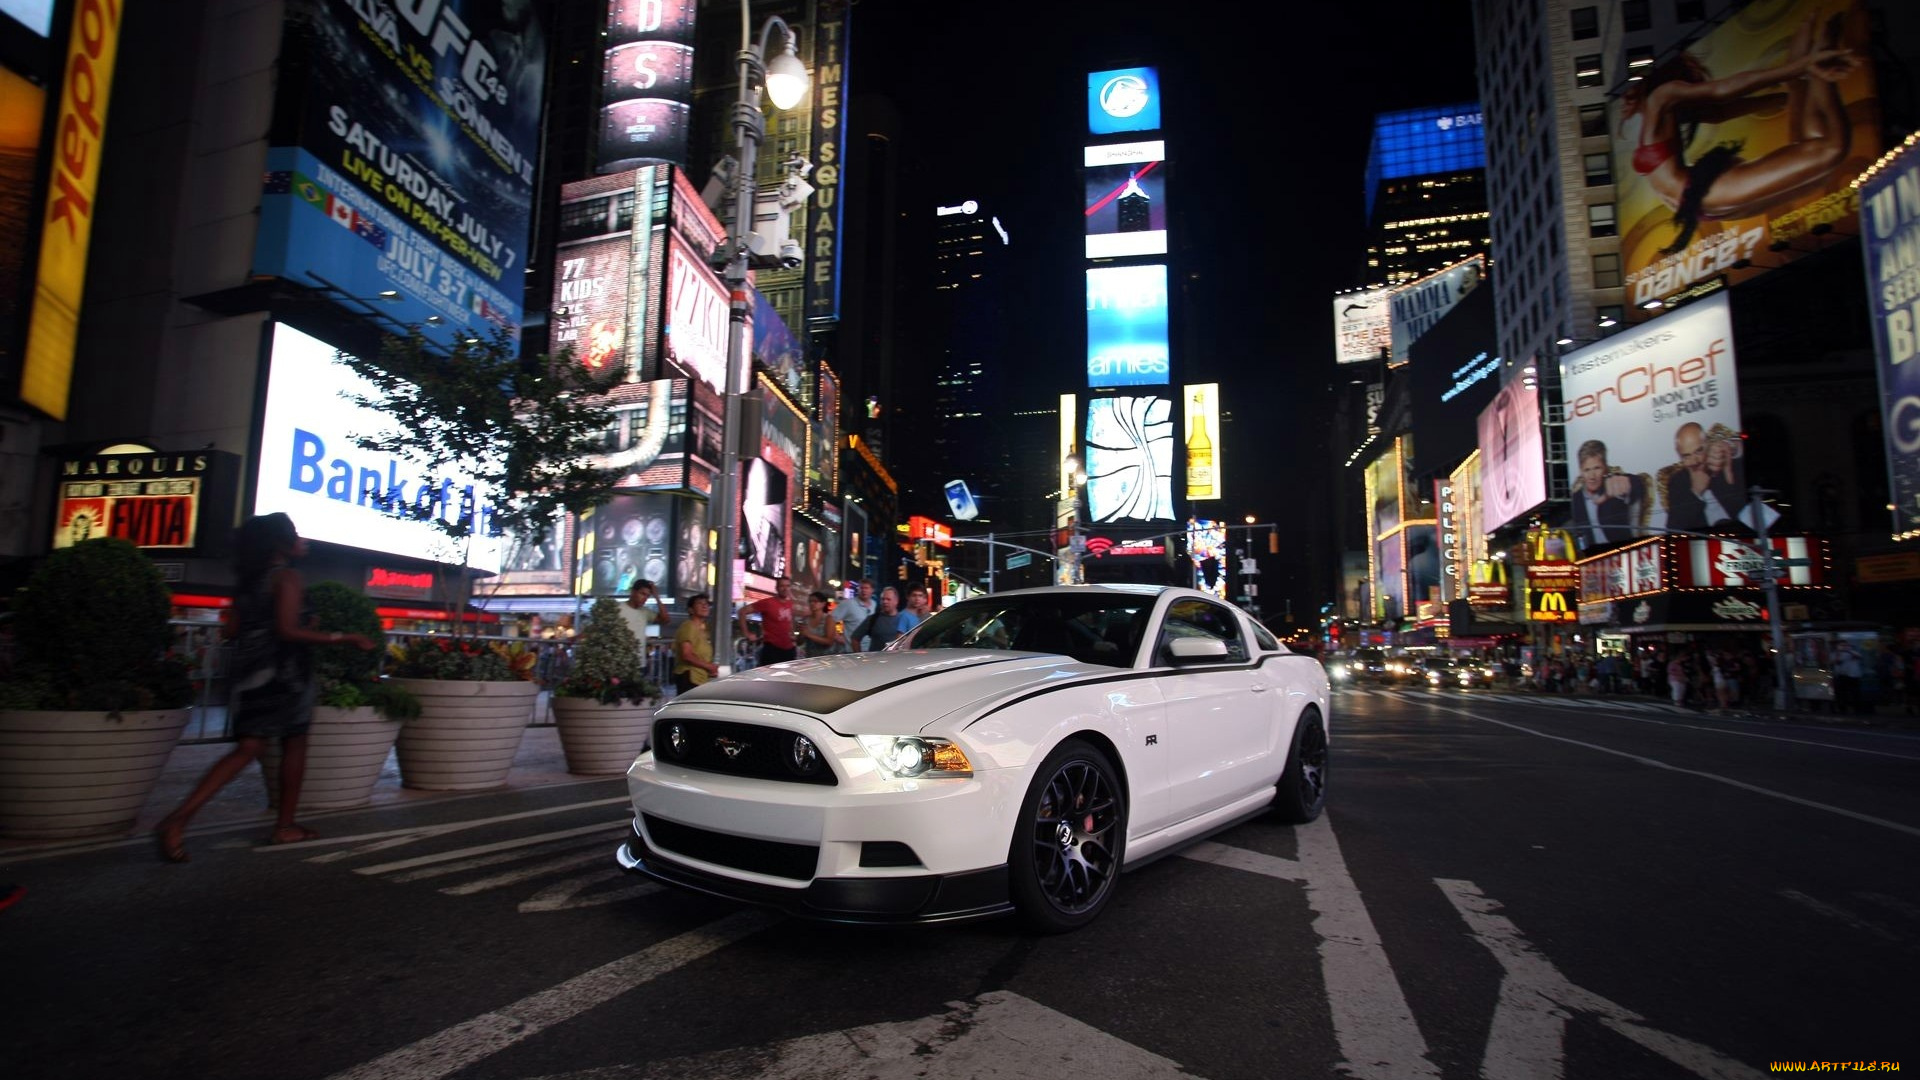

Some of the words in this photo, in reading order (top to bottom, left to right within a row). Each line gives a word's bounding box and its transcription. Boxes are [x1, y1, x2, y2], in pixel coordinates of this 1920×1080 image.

[820, 21, 842, 130] TIMES
[50, 0, 118, 244] odak
[328, 105, 455, 227] SATURDAY,
[456, 213, 504, 259] JULY
[505, 248, 516, 269] 7
[342, 150, 383, 193] LIVE
[384, 184, 410, 215] ON
[412, 205, 504, 281] PAY-PER-VIEW
[814, 142, 838, 283] SQUARE
[387, 236, 436, 283] JULY
[439, 270, 467, 305] 3-7
[560, 277, 604, 302] KIDS
[1652, 391, 1684, 408] MON
[1690, 379, 1718, 399] TUE
[1676, 398, 1707, 418] FOX
[1707, 393, 1719, 408] 5
[62, 455, 208, 476] MARQUIS
[289, 427, 408, 517] Bank
[108, 497, 188, 546] EVITA
